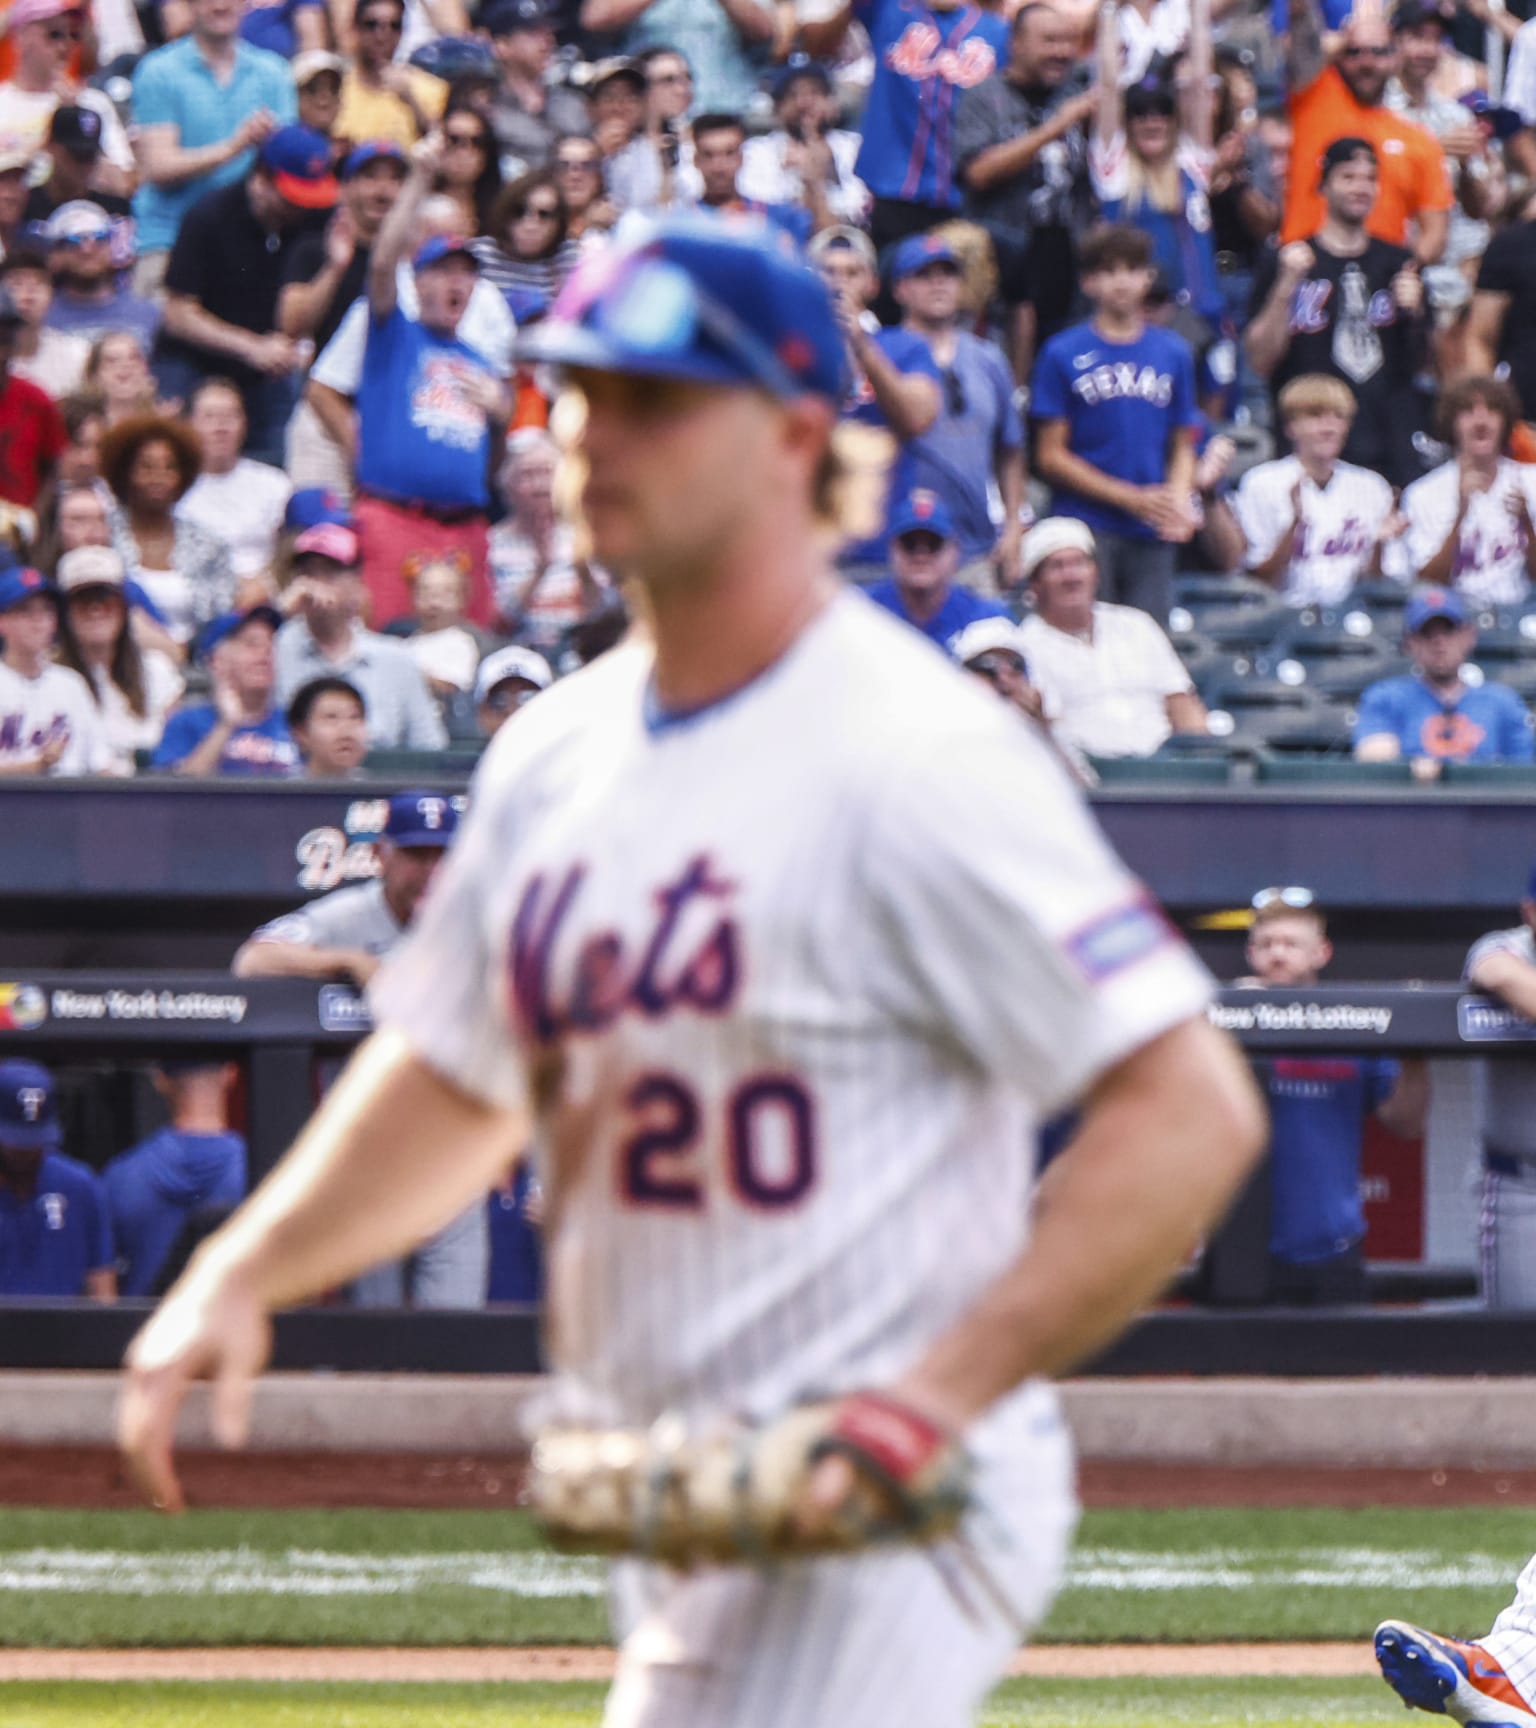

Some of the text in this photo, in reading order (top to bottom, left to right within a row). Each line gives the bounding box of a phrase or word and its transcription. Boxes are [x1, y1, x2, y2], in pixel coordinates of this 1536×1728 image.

[1072, 362, 1173, 408] TEXAS
[506, 848, 742, 1042] Mets
[52, 989, 248, 1024] New York Lottery
[1258, 1003, 1310, 1030] York
[1309, 1004, 1393, 1034] Lottery
[612, 1066, 822, 1216] 20
